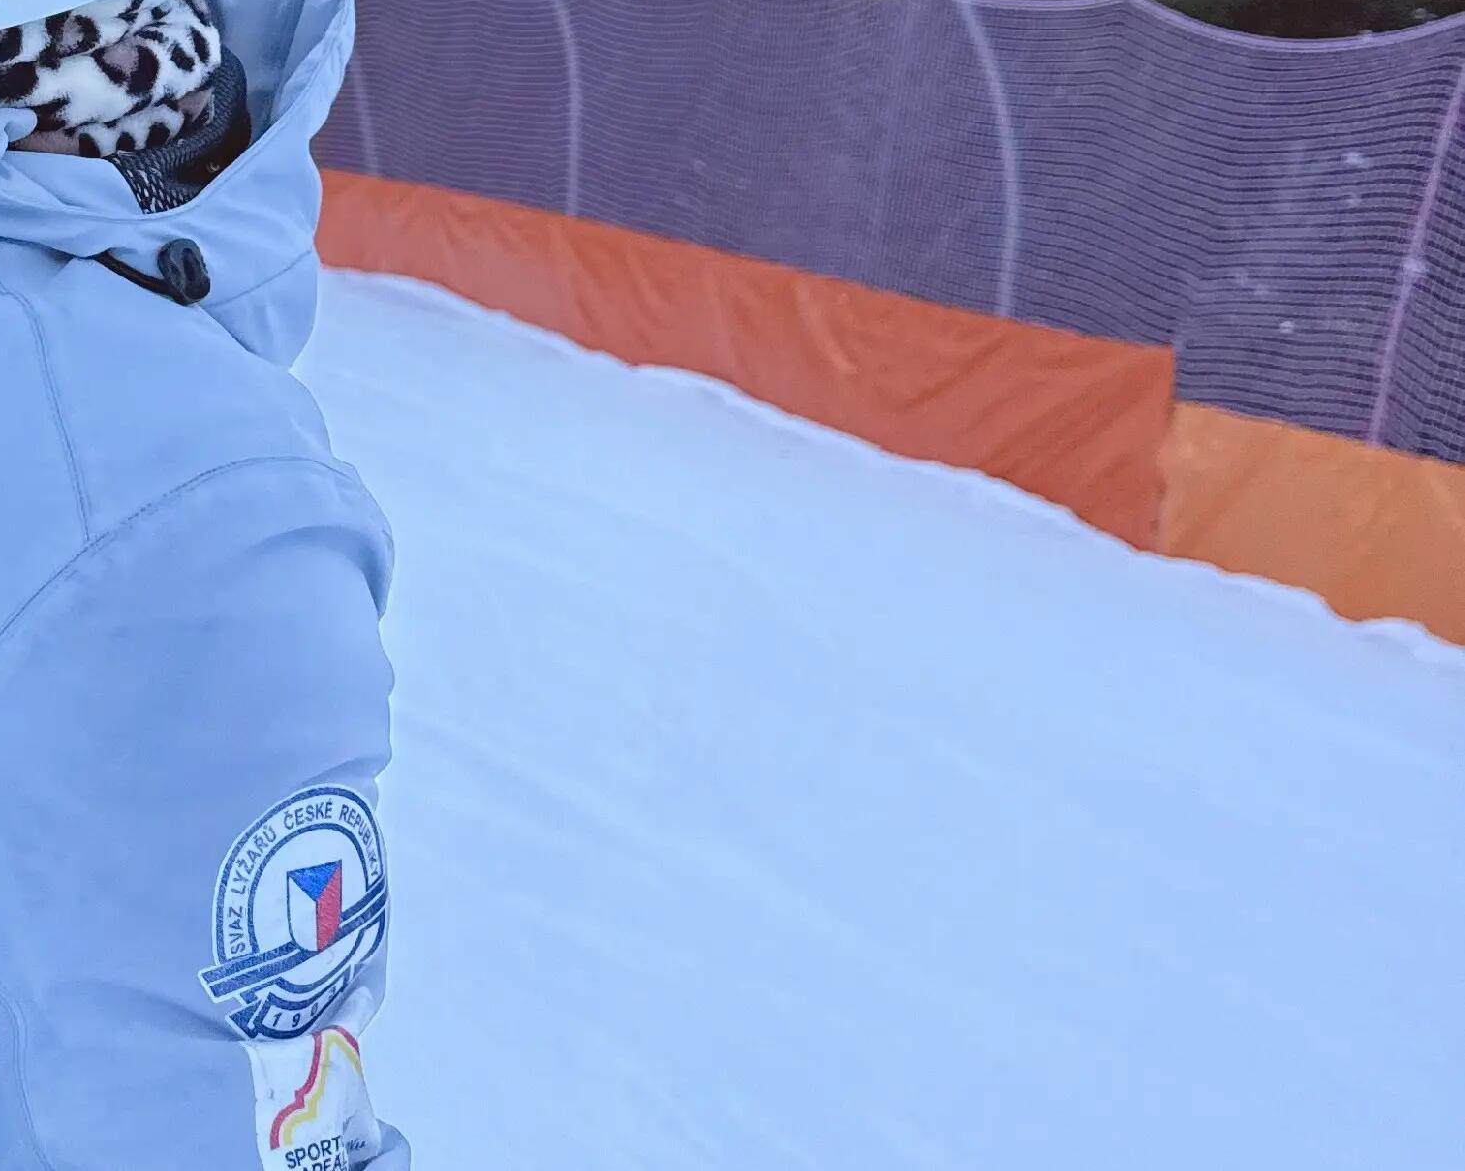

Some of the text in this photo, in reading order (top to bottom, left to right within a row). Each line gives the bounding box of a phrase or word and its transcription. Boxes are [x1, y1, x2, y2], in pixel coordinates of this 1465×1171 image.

[283, 798, 333, 830] ČESKÉ
[231, 824, 277, 895] LYŽAŘŮ
[229, 906, 246, 955] SVAZ
[285, 1135, 341, 1169] SPORT
